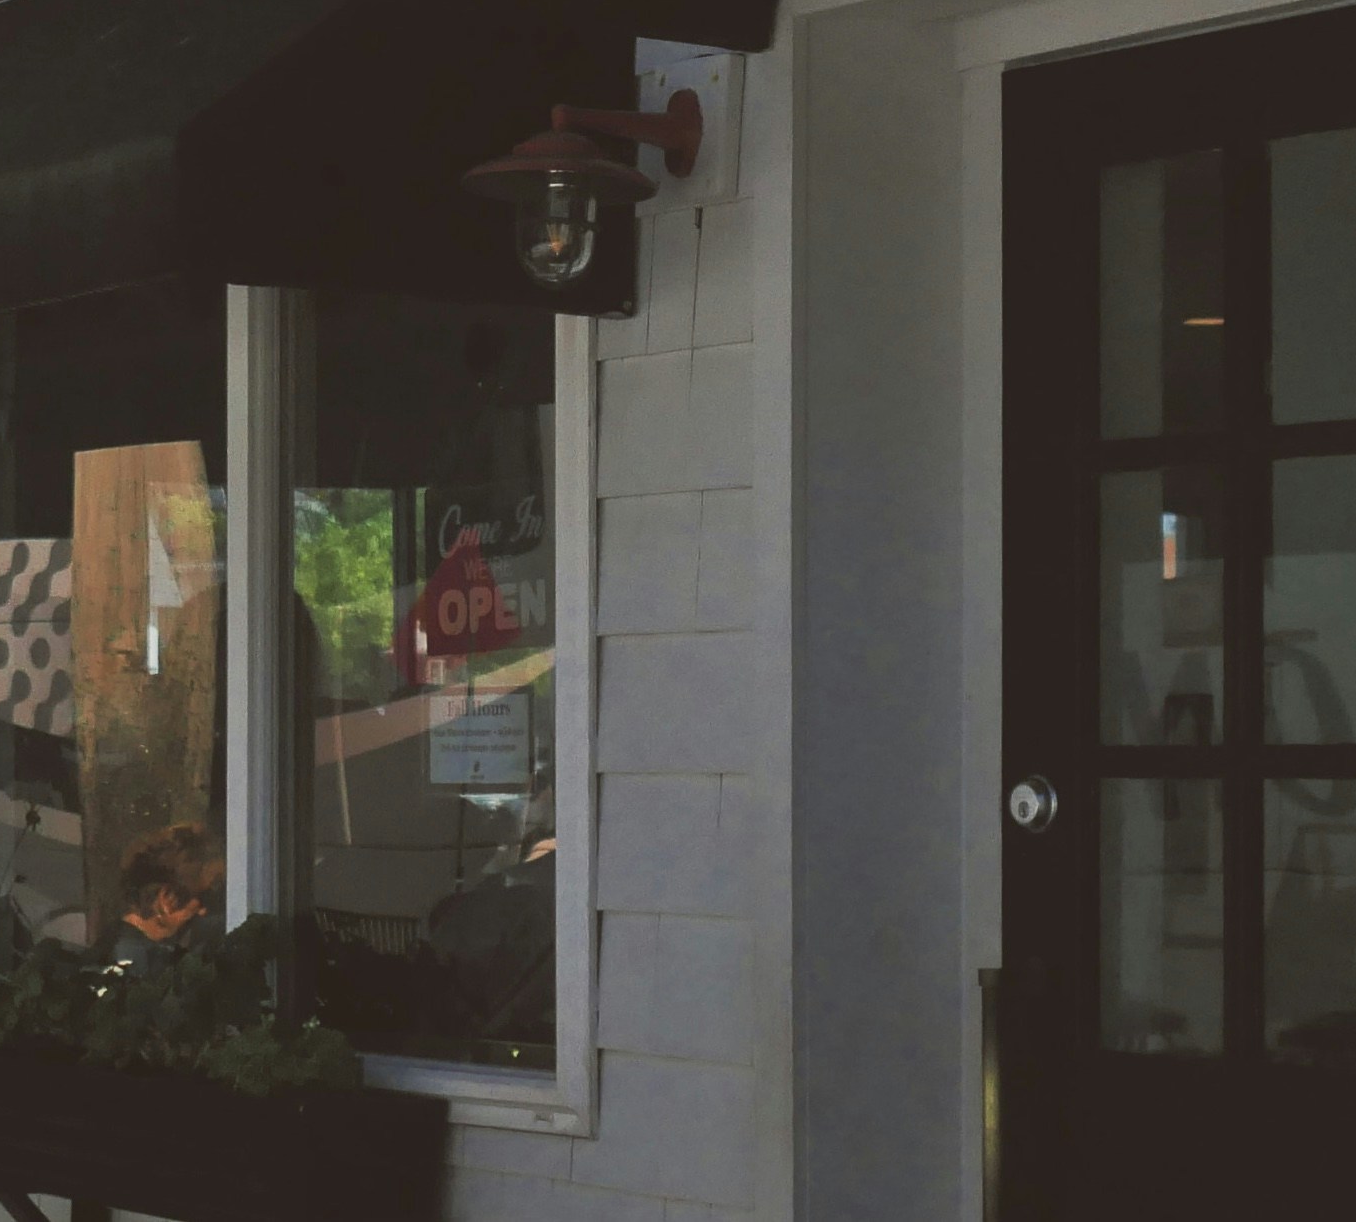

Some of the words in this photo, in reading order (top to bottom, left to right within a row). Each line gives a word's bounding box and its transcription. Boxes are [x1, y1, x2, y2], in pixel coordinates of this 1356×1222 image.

[438, 504, 502, 558] Come
[509, 495, 543, 542] In
[438, 577, 547, 636] OPEN
